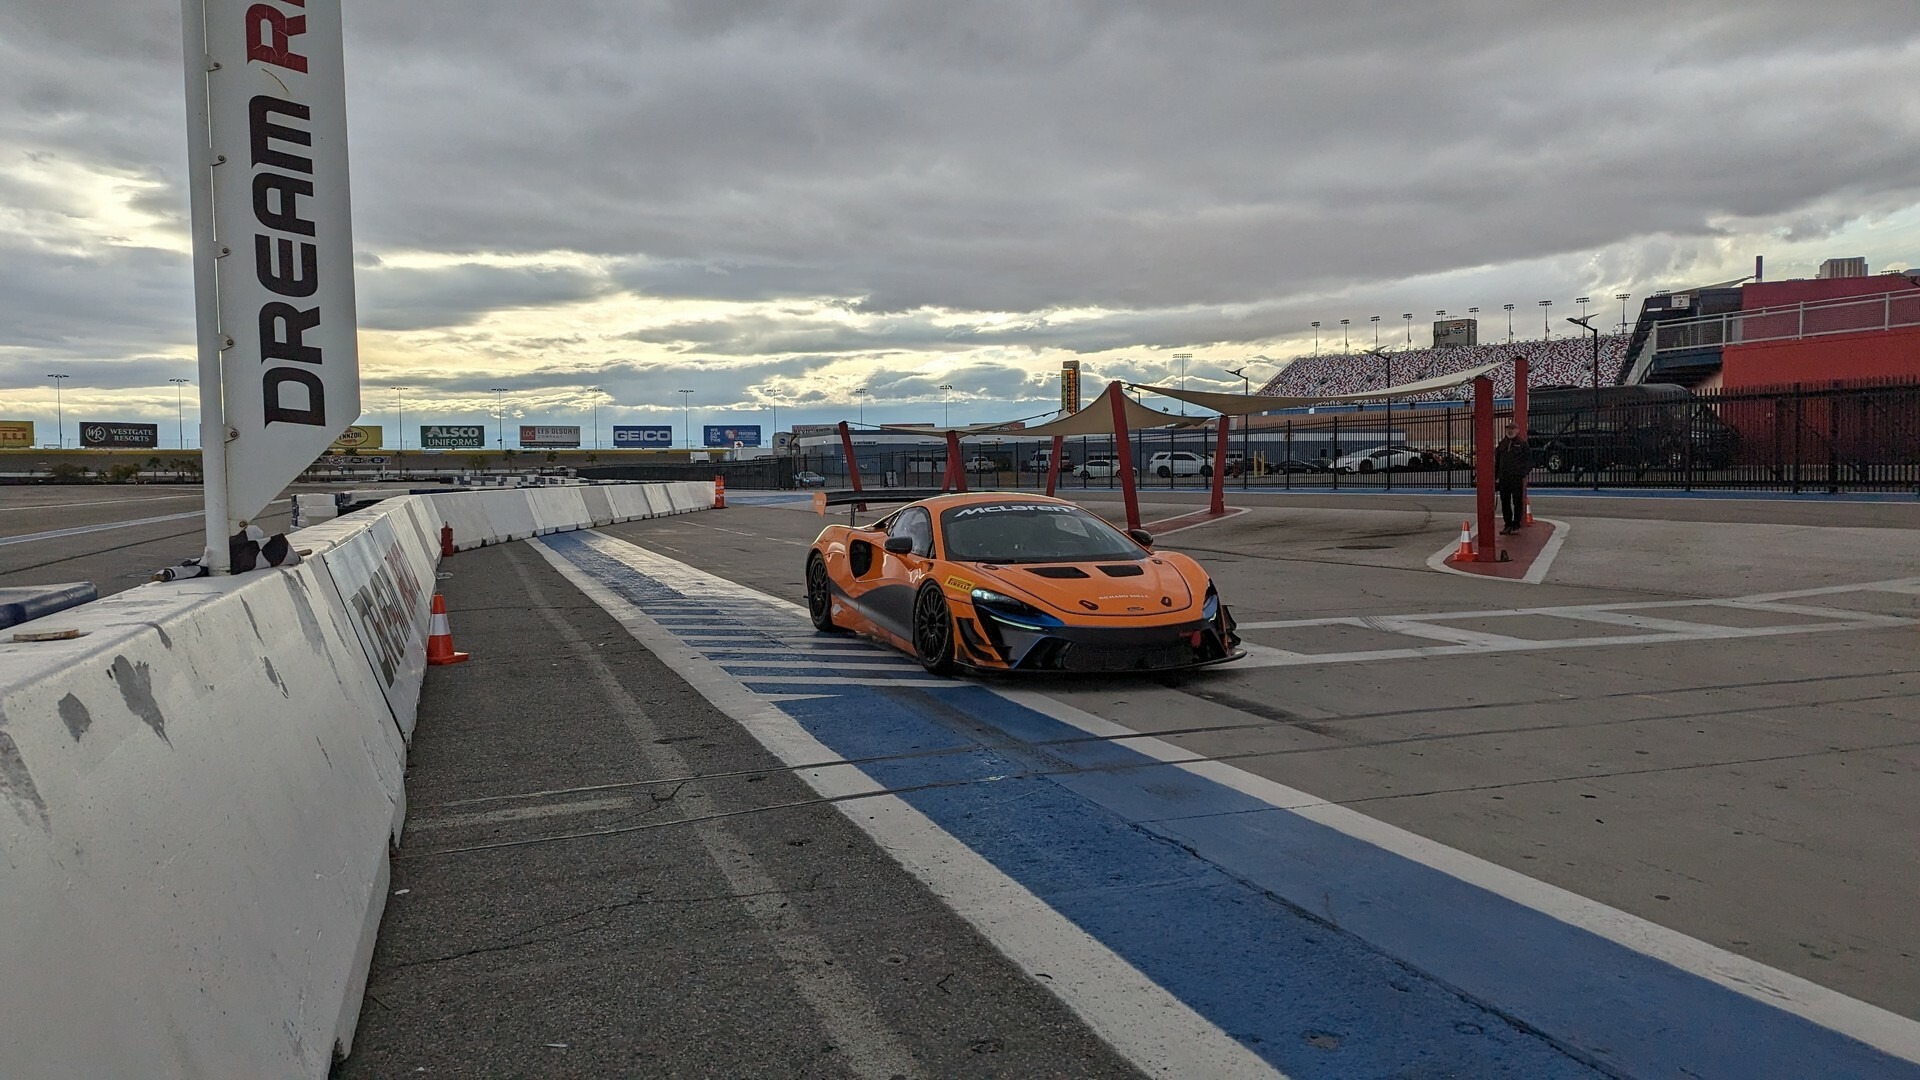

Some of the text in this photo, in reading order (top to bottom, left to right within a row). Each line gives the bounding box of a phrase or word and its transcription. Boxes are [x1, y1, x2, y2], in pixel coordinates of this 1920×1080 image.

[245, 0, 327, 429] DREAM R
[109, 428, 154, 436] WESTGATE
[339, 432, 363, 440] ENNZOIL
[426, 426, 480, 438] ALSCO
[614, 430, 671, 441] GEICO
[428, 438, 479, 446] UNIFORMS
[955, 504, 1077, 518] McLaren
[947, 577, 972, 591] PIRELLI
[350, 564, 412, 690] DREAM
